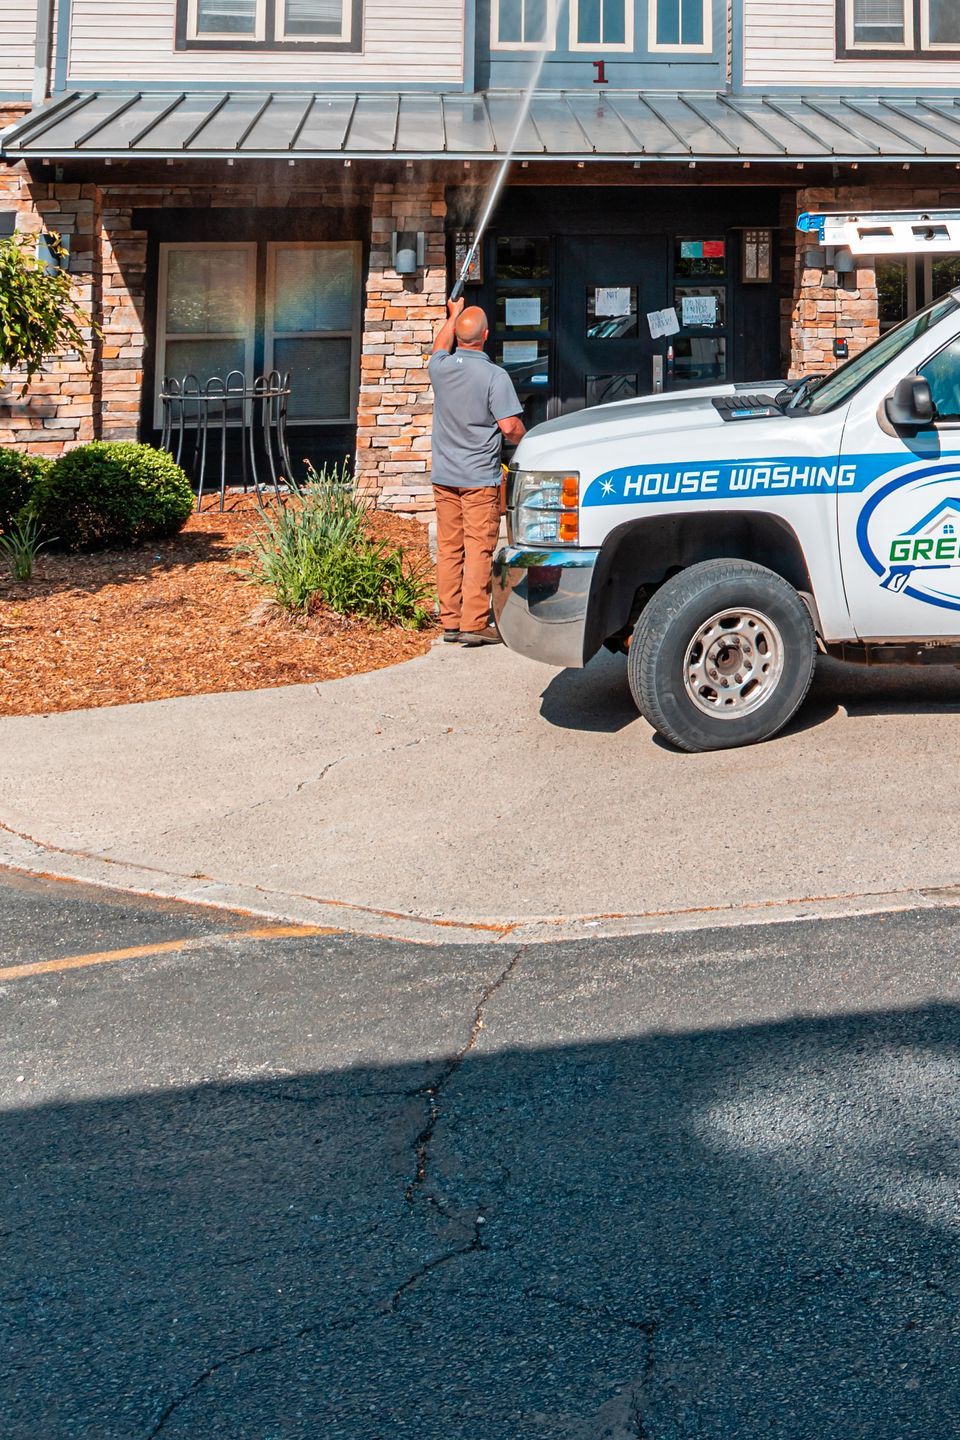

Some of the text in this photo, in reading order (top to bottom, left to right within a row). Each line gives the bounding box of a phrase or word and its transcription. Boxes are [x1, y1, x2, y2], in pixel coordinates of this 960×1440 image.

[592, 60, 609, 83] 1
[623, 464, 857, 497] HOUSE WASHING
